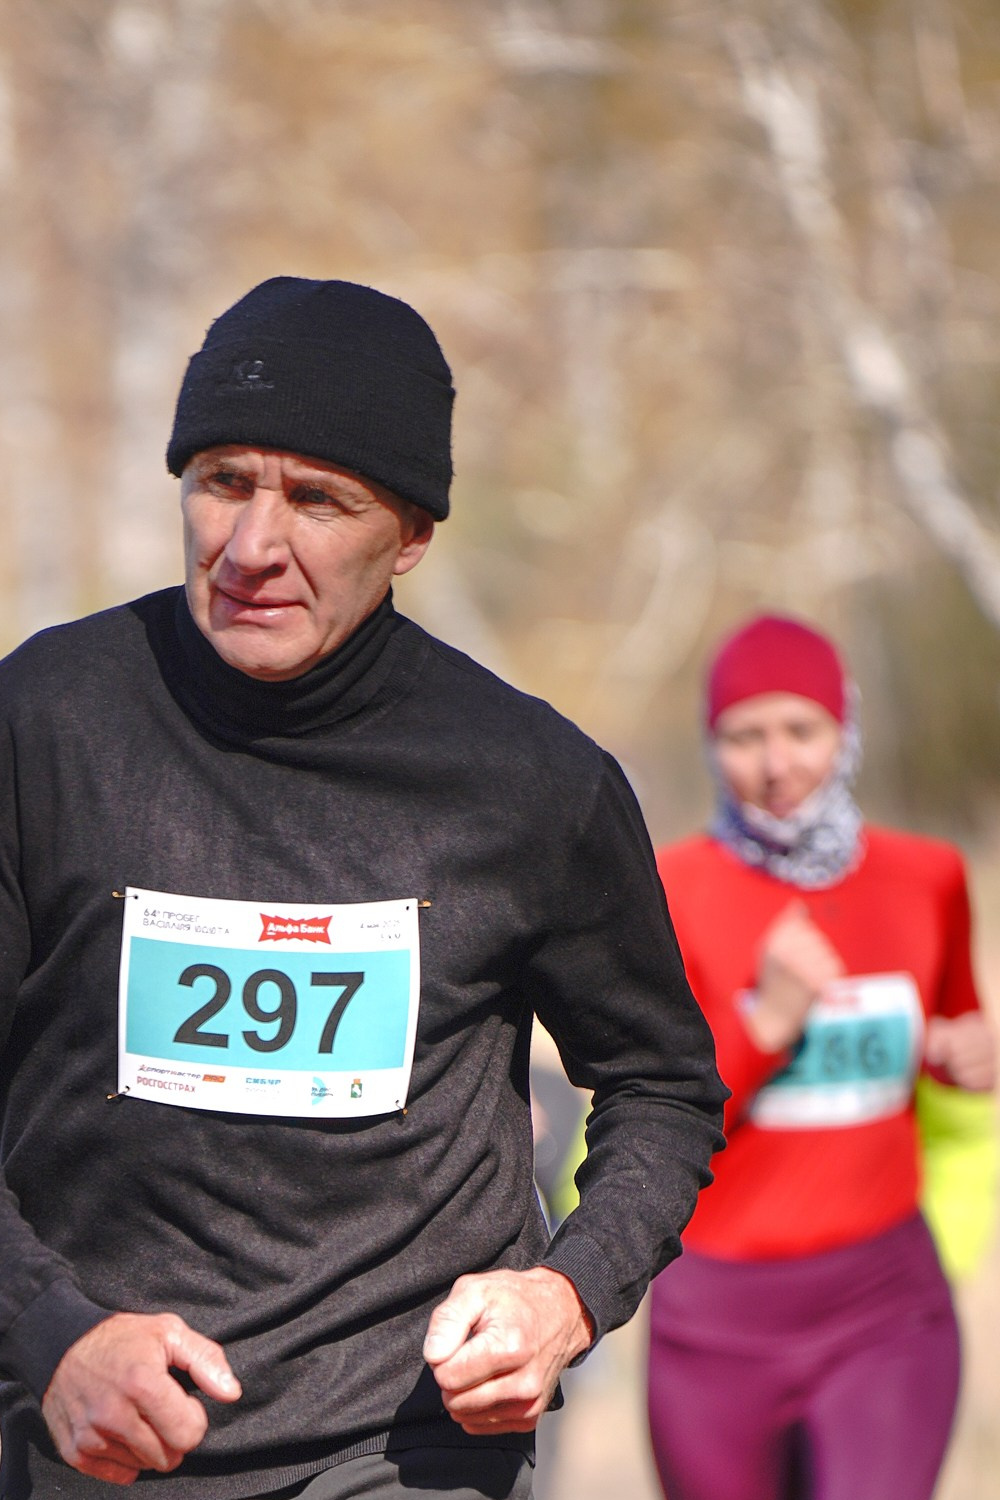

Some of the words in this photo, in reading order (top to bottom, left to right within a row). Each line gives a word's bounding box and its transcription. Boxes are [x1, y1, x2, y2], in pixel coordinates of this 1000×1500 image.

[162, 911, 200, 923] ПРОБЕГ
[267, 922, 299, 935] Альфа
[300, 924, 326, 934] Банк
[173, 963, 365, 1054] 297
[137, 1076, 196, 1092] РОСГОССТРАХ
